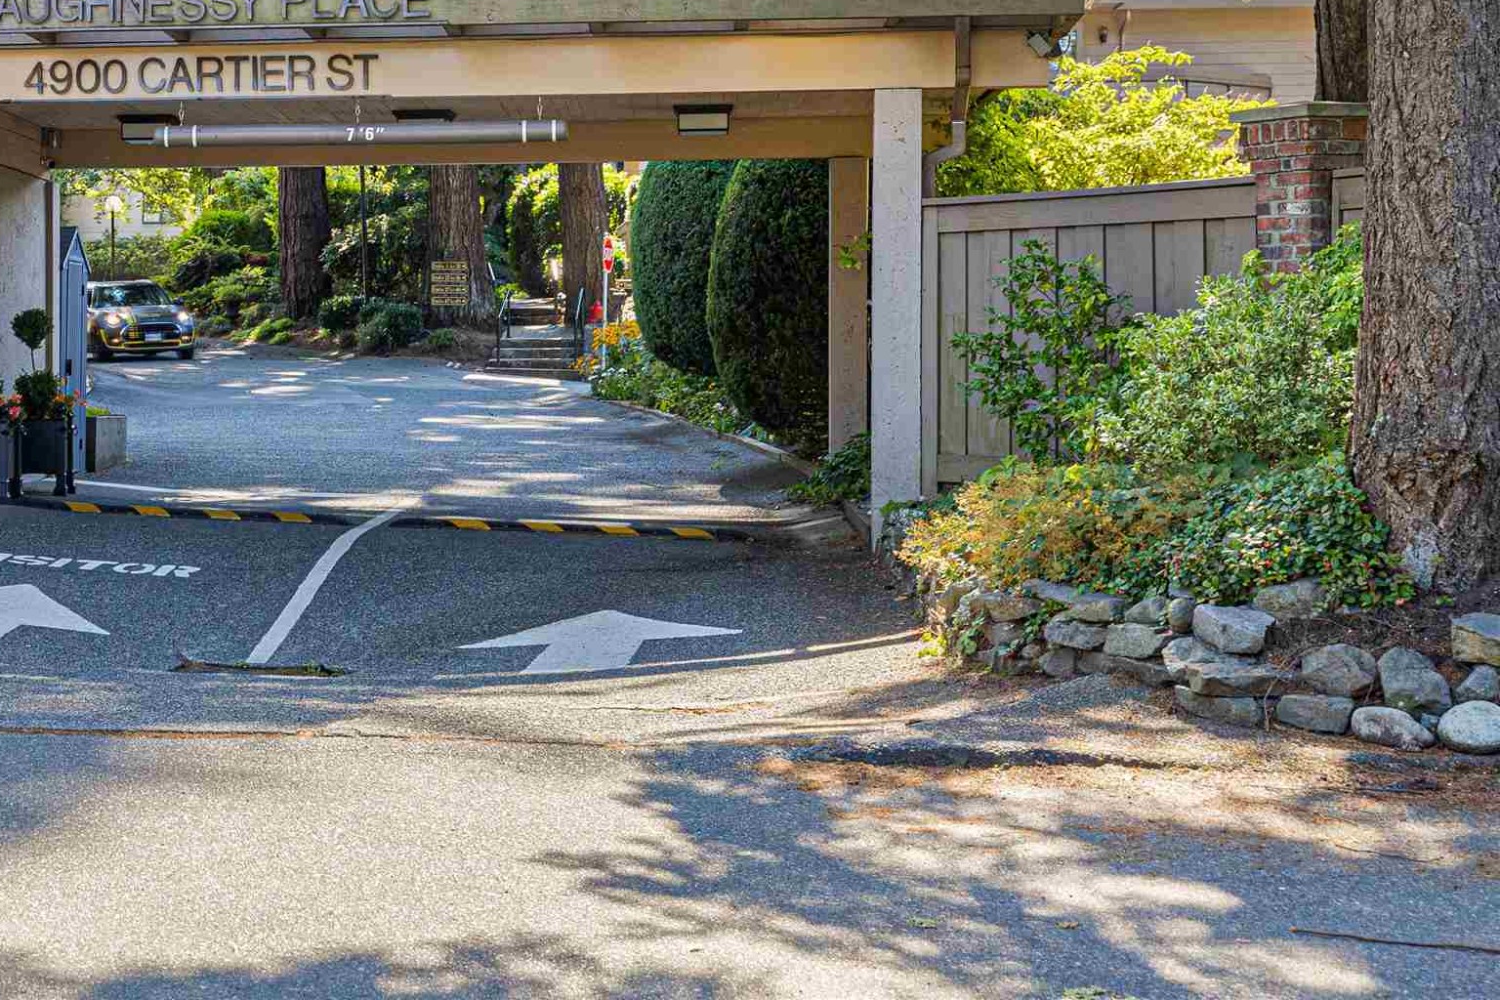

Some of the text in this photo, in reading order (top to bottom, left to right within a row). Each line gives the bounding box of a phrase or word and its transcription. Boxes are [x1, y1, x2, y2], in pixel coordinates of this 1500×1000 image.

[23, 53, 380, 95] 4900 CARTIER ST
